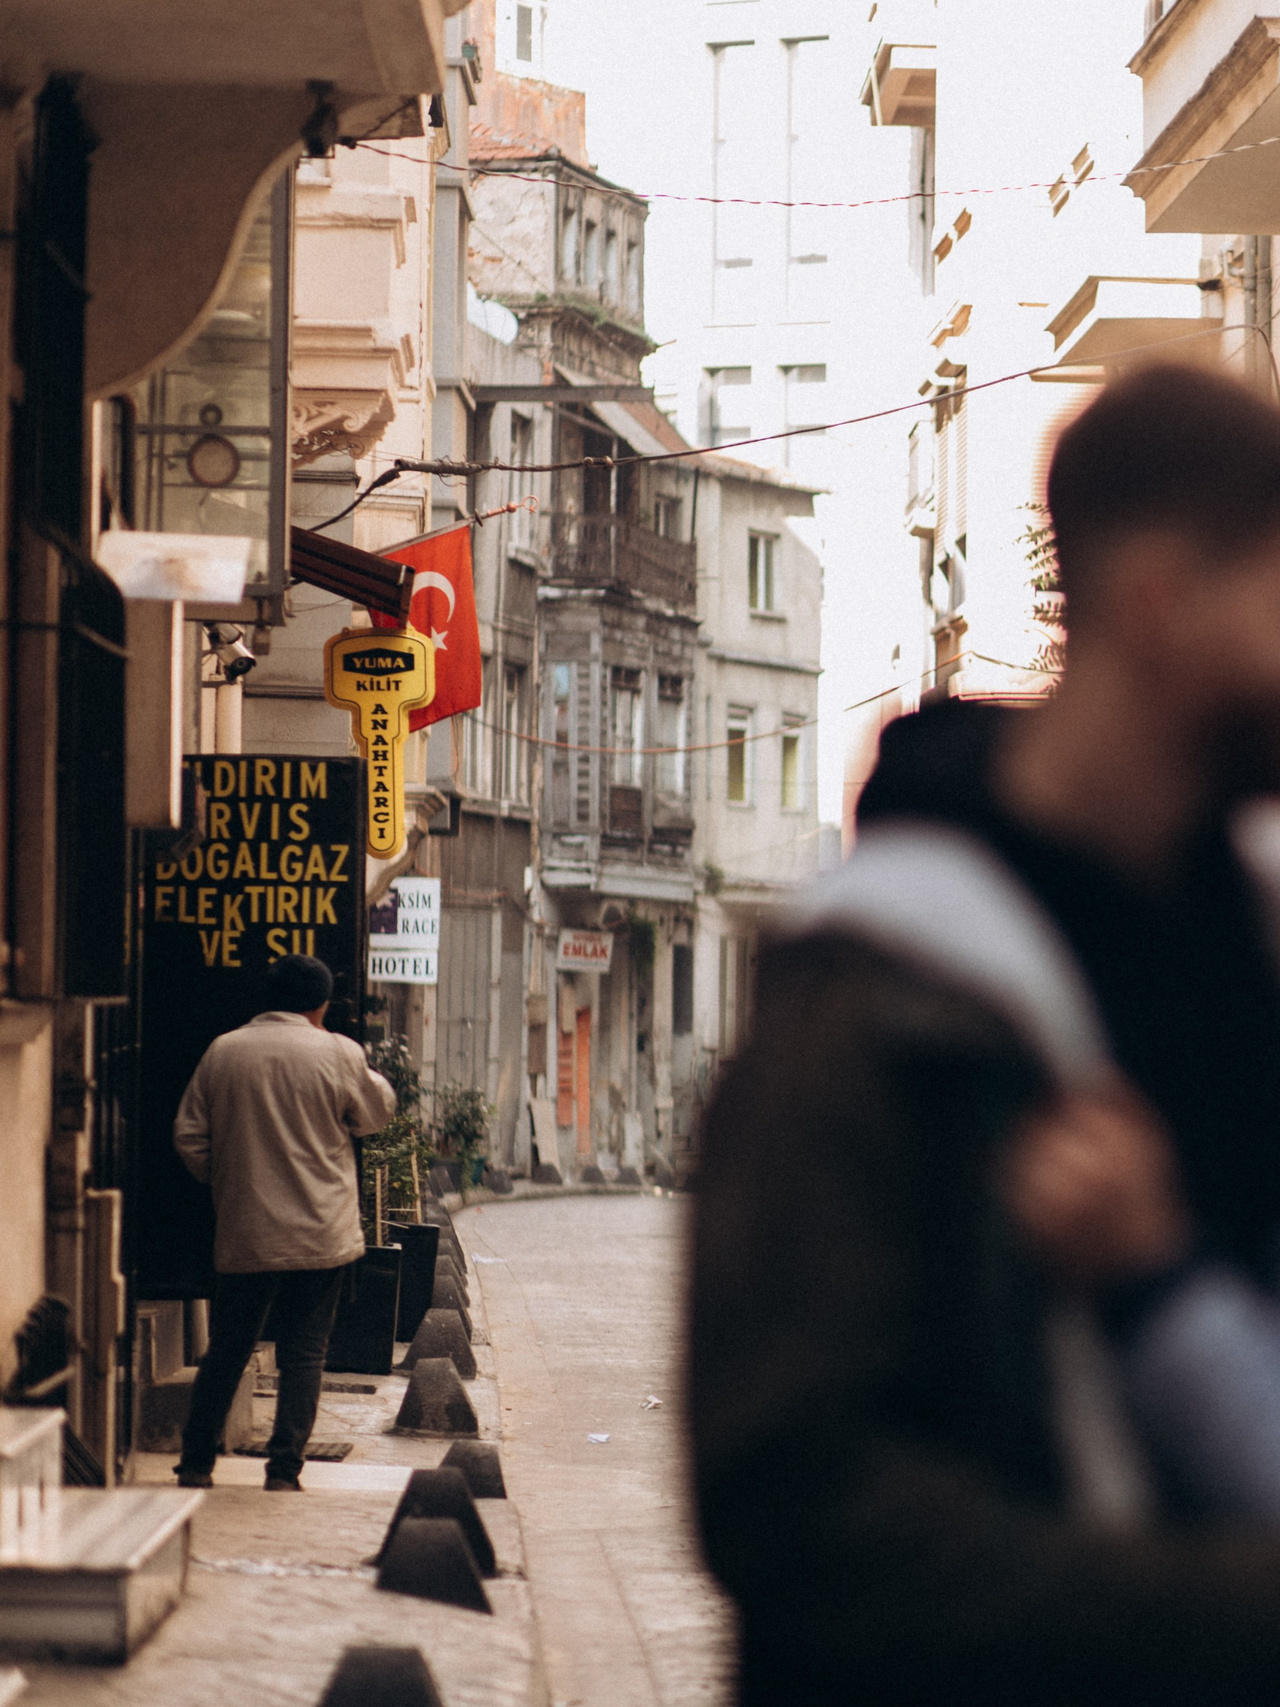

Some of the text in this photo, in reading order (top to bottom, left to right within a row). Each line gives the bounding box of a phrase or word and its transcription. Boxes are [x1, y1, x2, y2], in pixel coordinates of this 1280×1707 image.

[352, 657, 405, 669] YUMA
[356, 677, 402, 691] KİLİT
[184, 758, 328, 799] DIRIM
[371, 703, 389, 839] ANAHTARCI
[210, 802, 310, 841] RVIS
[154, 886, 338, 931] ELEKTIRIK
[398, 890, 432, 909] KSİM
[401, 918, 438, 934] RACE
[199, 928, 315, 967] VE SU
[563, 941, 608, 959] EMLAK
[371, 956, 434, 976] HOTEL
